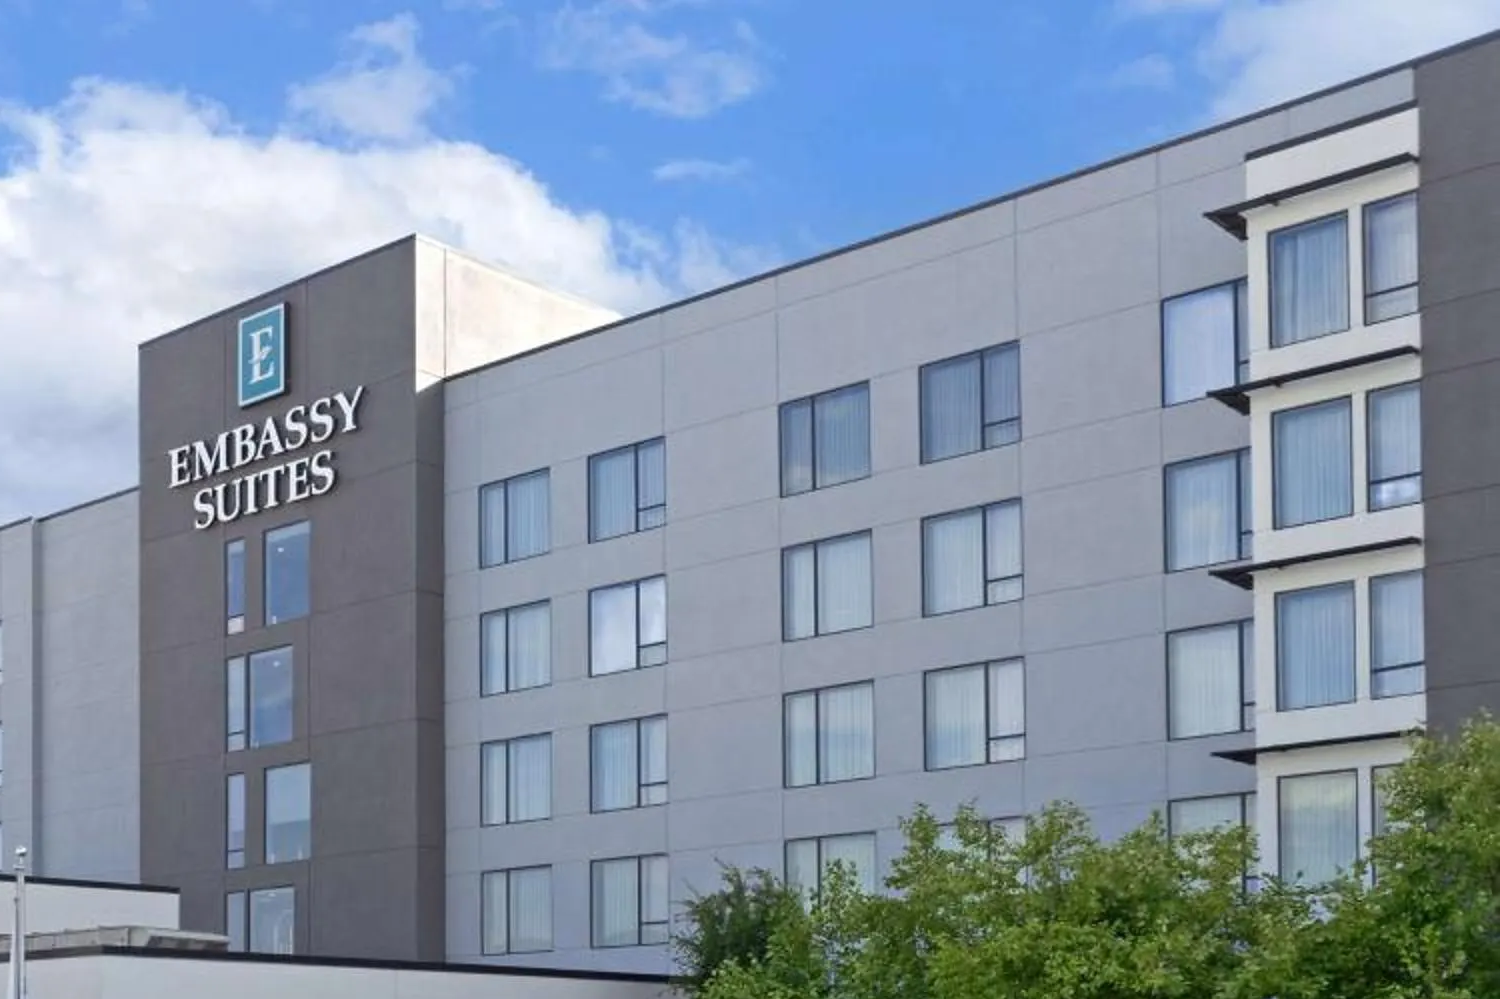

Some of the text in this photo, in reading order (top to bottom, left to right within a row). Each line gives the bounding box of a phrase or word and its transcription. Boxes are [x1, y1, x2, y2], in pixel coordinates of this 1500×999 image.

[248, 326, 275, 385] E
[167, 385, 365, 489] EMBASSY
[193, 450, 335, 530] SUITES
